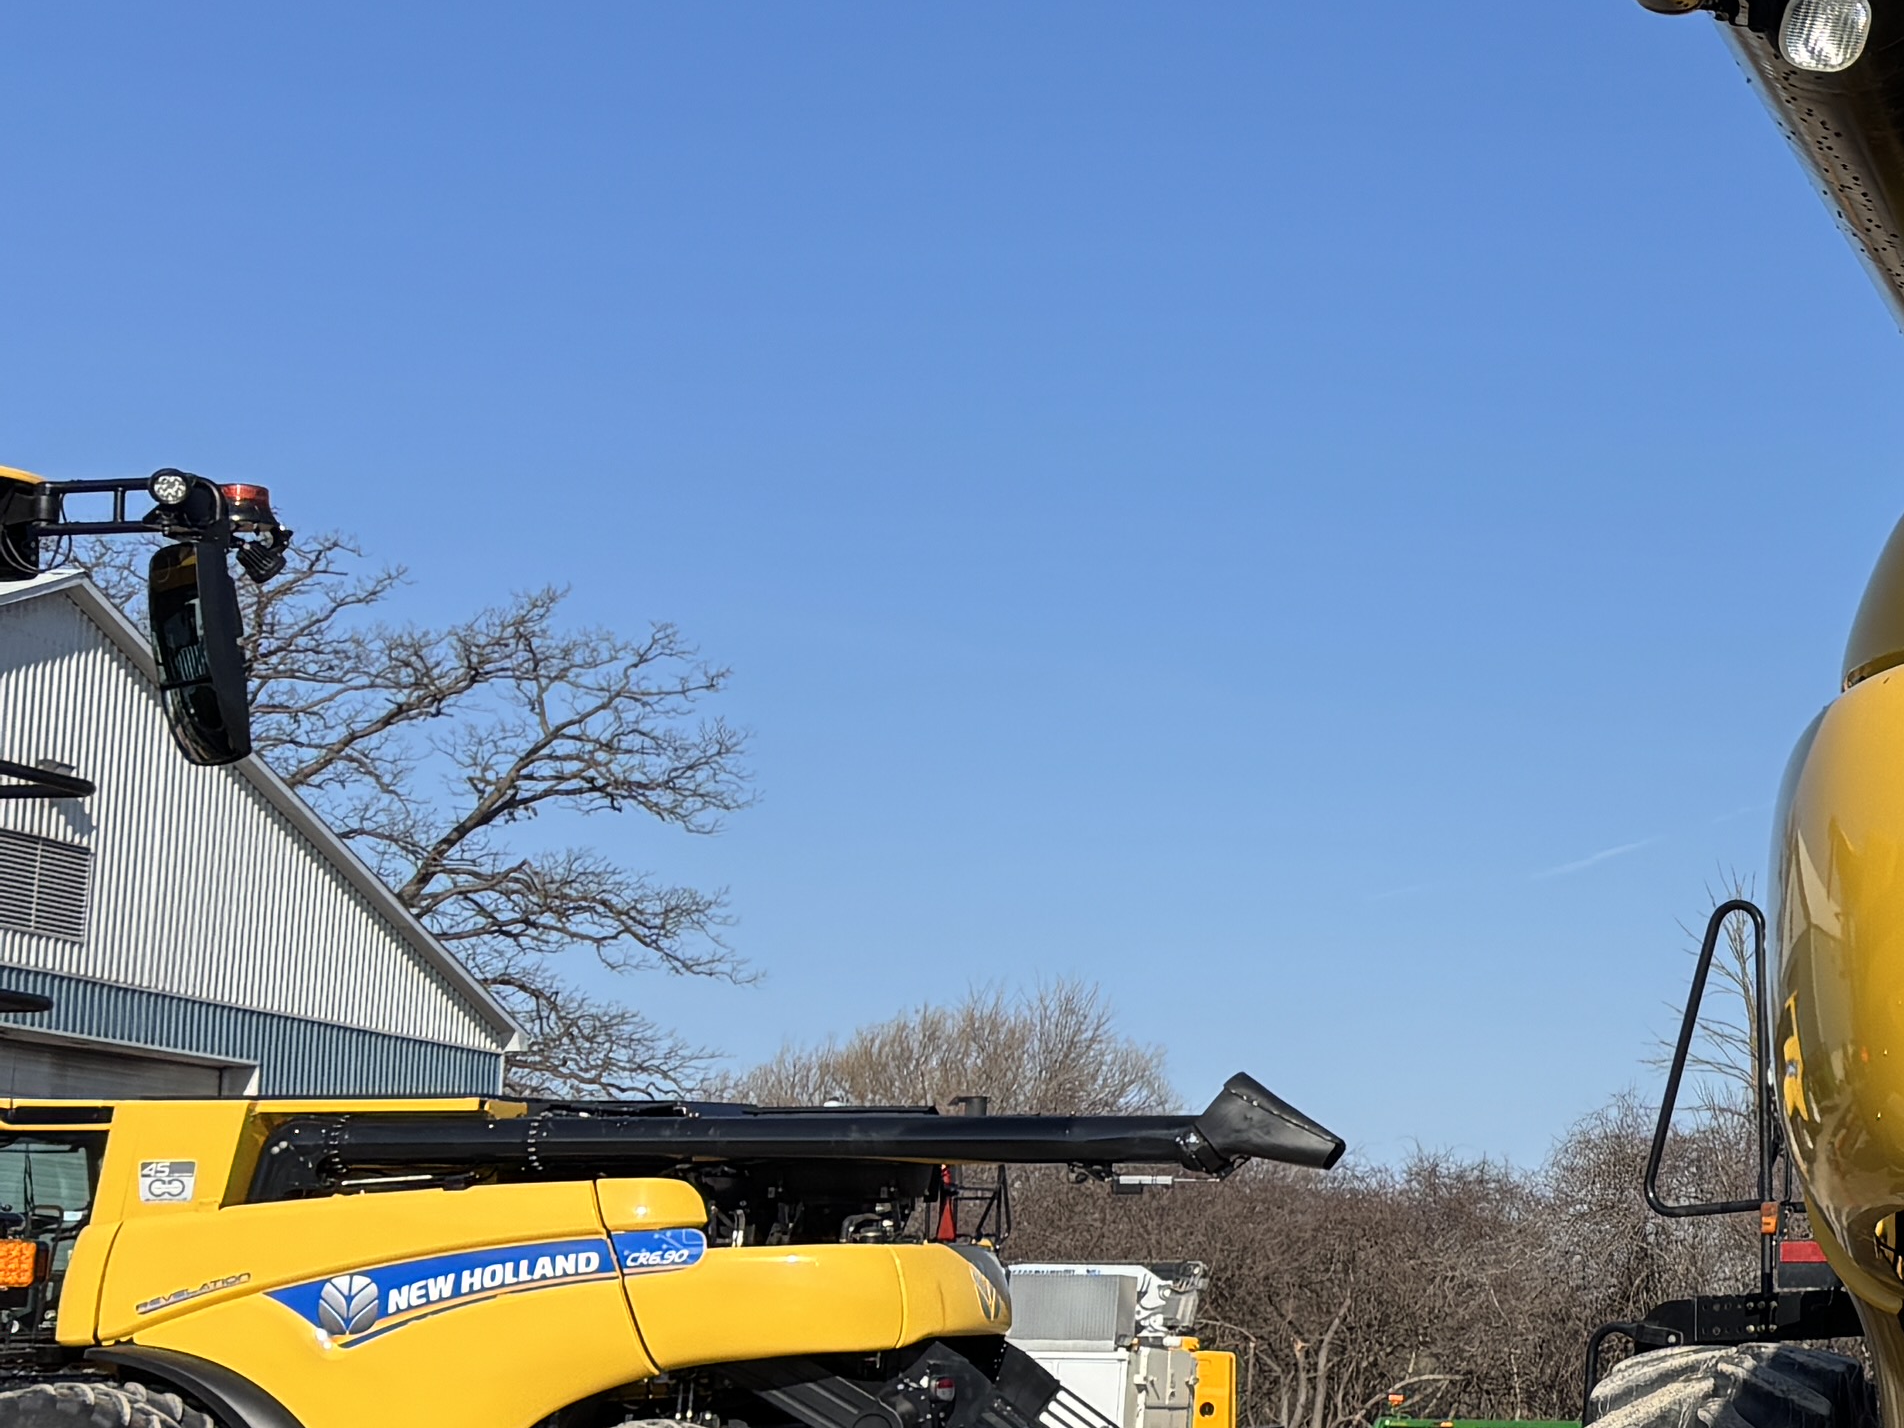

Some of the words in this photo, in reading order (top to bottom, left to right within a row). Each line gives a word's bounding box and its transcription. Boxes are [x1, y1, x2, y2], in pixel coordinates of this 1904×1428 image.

[142, 1162, 170, 1177] 45
[626, 1248, 689, 1267] CR6.90
[387, 1273, 456, 1314] NEW
[460, 1251, 600, 1293] HOLLAND
